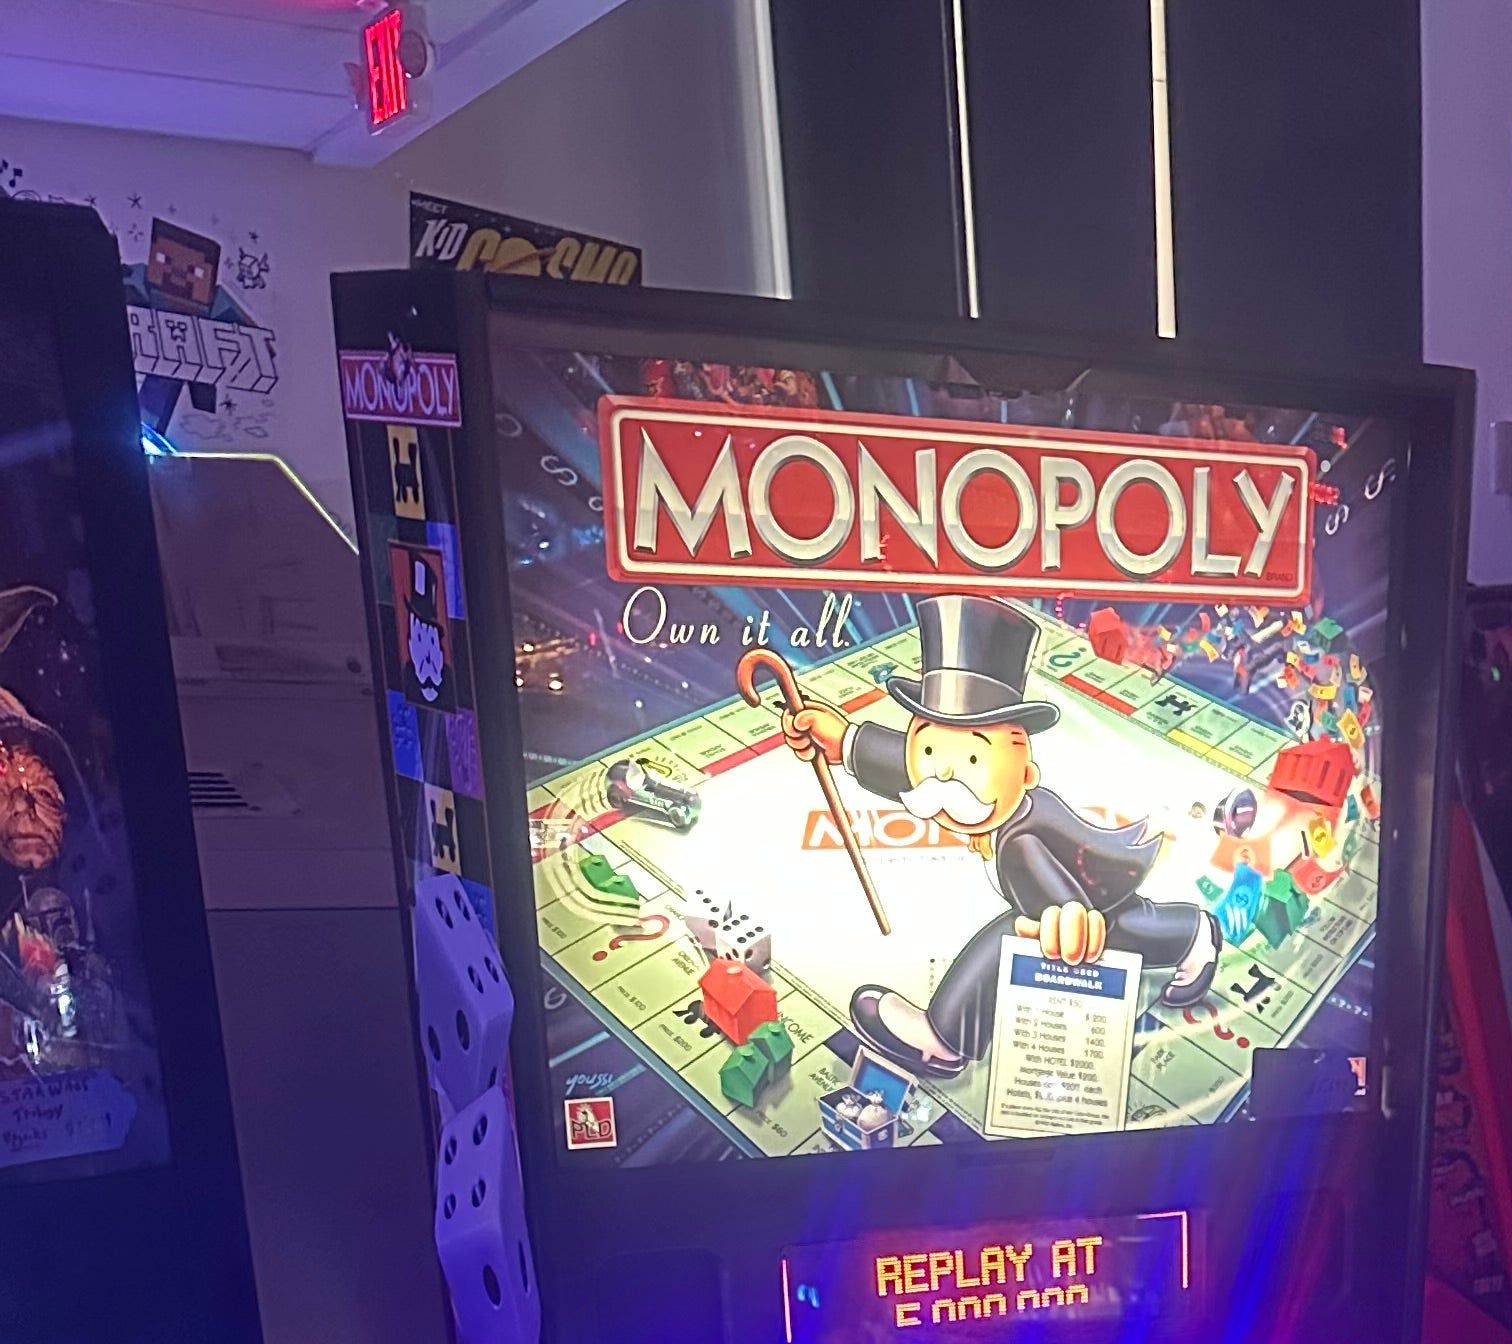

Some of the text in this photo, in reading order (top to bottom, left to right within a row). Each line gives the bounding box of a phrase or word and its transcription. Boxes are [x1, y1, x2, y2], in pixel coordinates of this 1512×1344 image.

[415, 219, 468, 261] KID
[345, 362, 455, 416] MONOPOLY
[633, 426, 1297, 579] MONOPOLY
[623, 586, 720, 646] Own
[741, 614, 772, 647] it
[876, 1236, 1103, 1297] REPLAY AT
